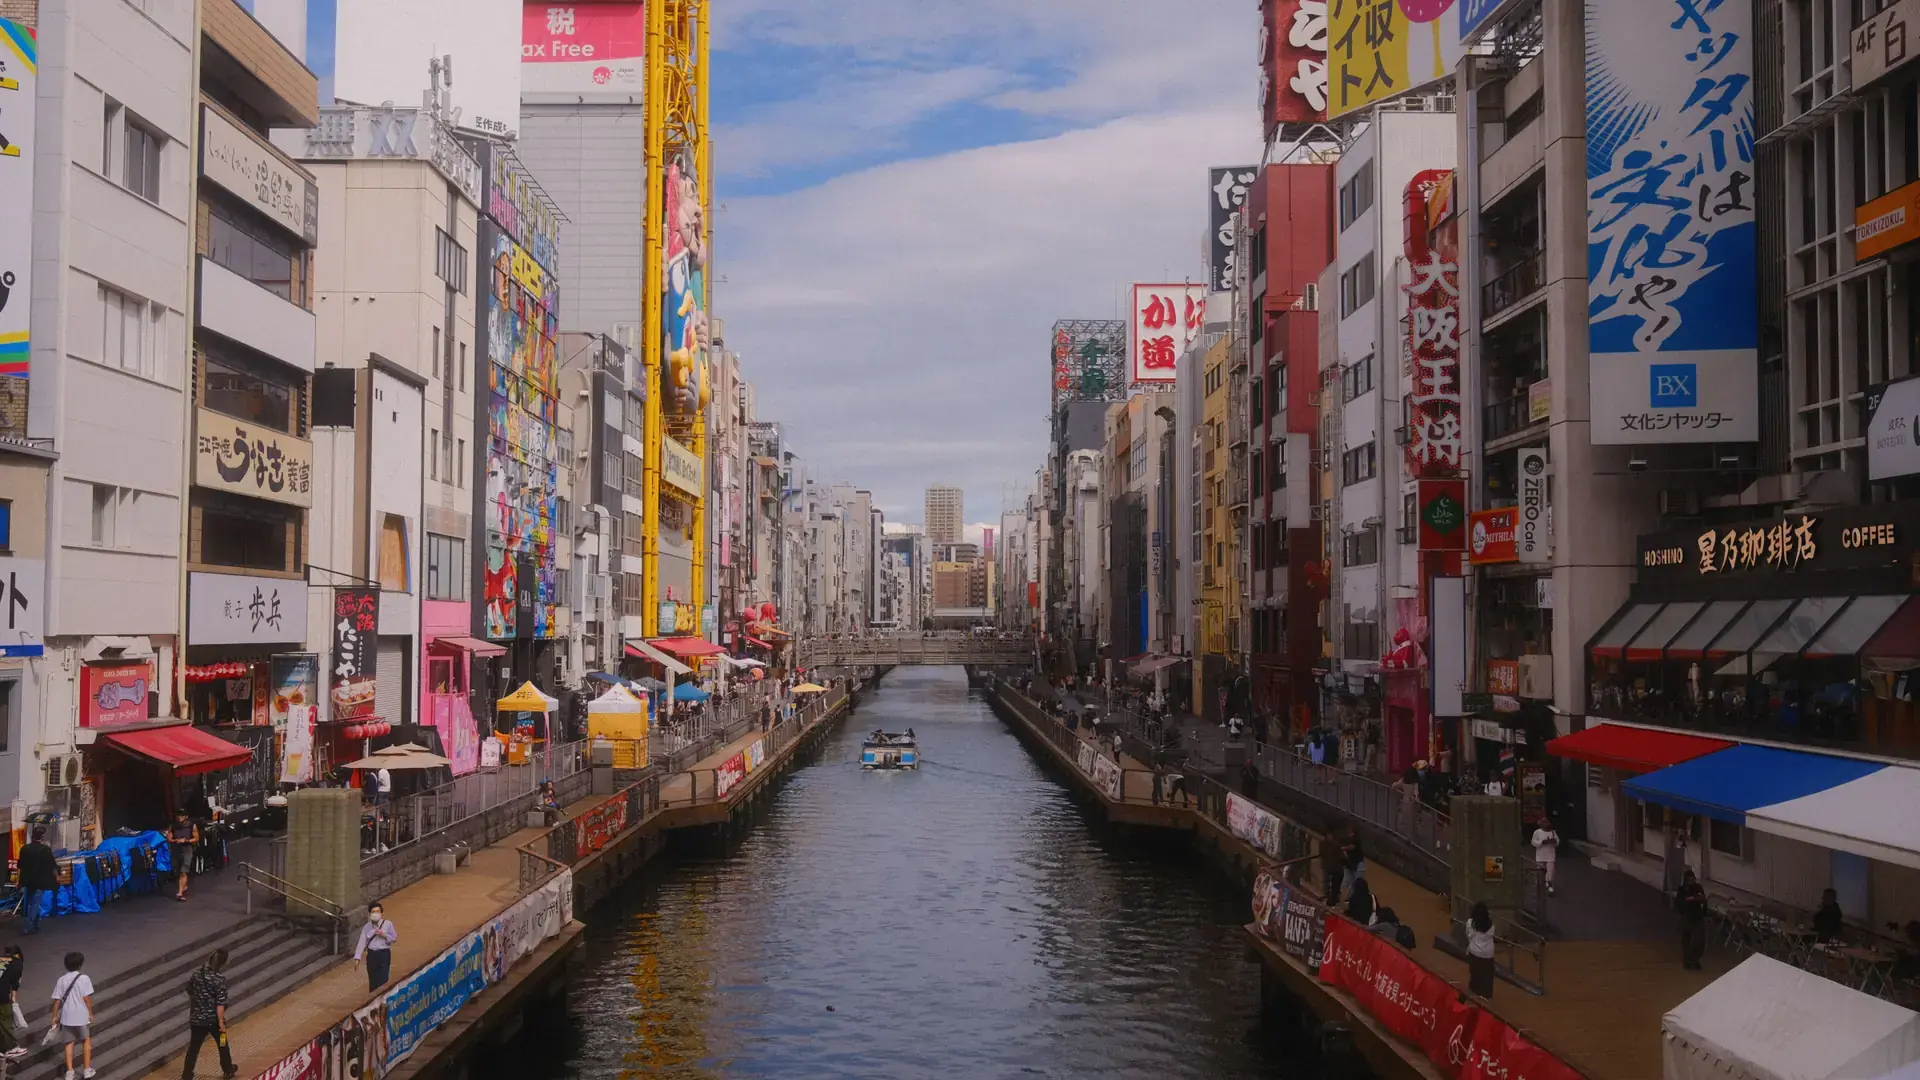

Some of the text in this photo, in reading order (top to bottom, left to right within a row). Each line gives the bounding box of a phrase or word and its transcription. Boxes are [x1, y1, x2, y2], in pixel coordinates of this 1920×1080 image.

[546, 8, 575, 35] 税
[521, 40, 595, 57] ax Free
[1365, 2, 1393, 96] 収入
[1855, 23, 1876, 54] 4F
[477, 116, 507, 131] 作成
[1856, 211, 1900, 240] TORIKIZOKU
[1141, 335, 1178, 370] 道
[1401, 249, 1460, 468] 大阪王将
[1656, 375, 1692, 396] BX
[1868, 394, 1880, 411] 2F
[216, 426, 286, 493] うなぎ
[1486, 531, 1514, 543] MITHILA
[1697, 515, 1817, 575] 星乃珈琲店
[1841, 524, 1895, 549] COFFEE
[1644, 547, 1684, 566] HOSHINO
[248, 585, 282, 634] 歩兵
[356, 594, 375, 632] 大阪
[335, 617, 358, 700] たこやき
